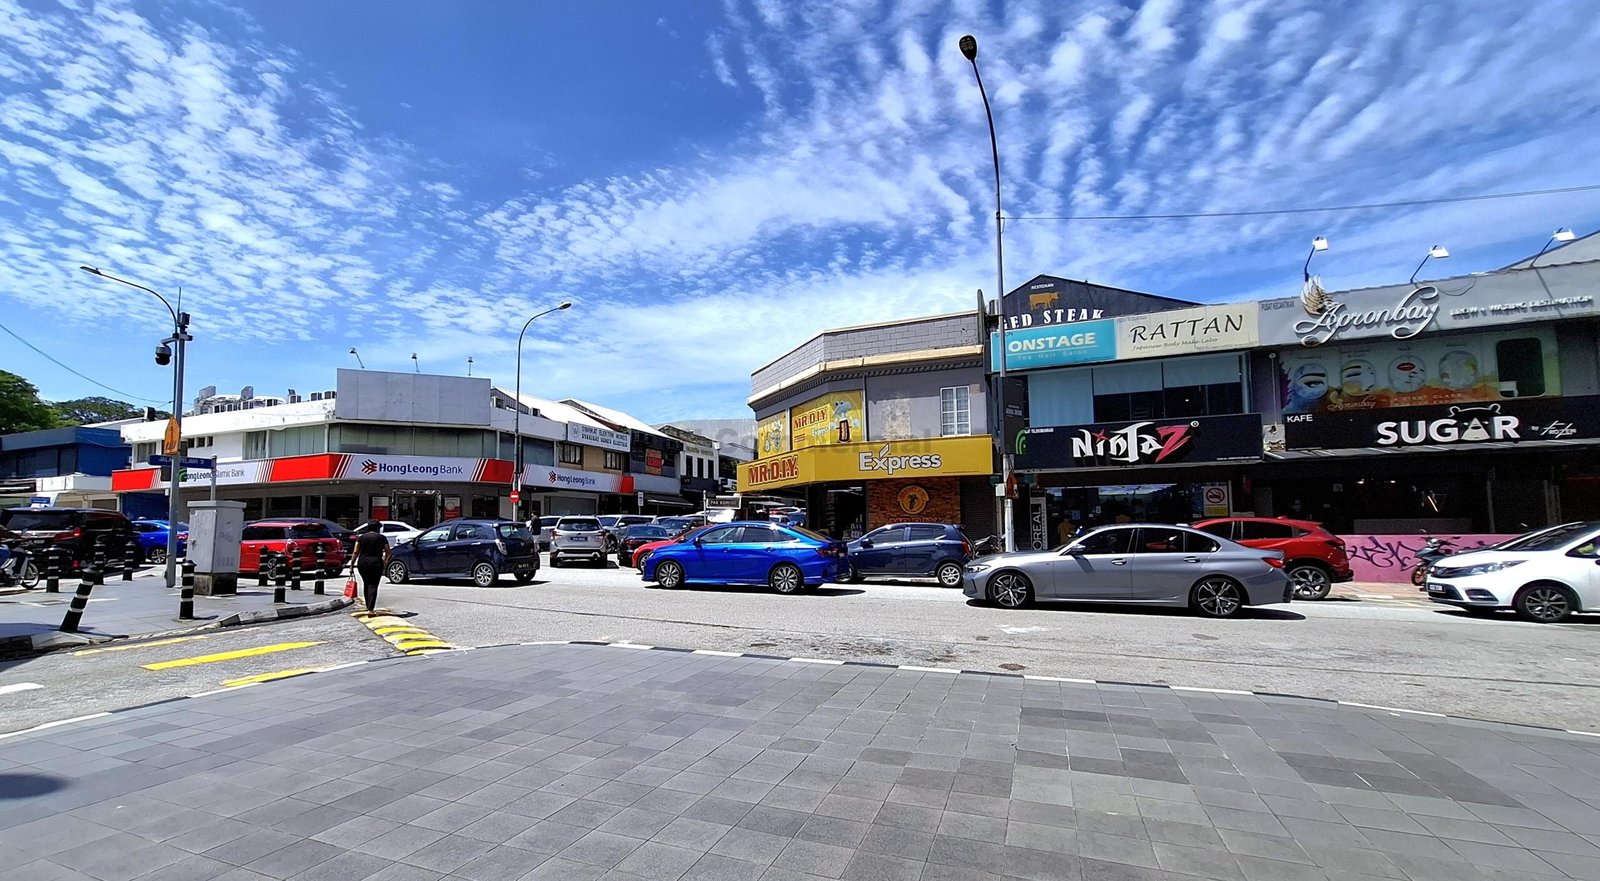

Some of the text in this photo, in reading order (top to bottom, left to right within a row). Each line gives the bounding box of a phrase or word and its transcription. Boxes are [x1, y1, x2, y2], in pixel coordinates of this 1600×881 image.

[1043, 308, 1104, 324] STEAK
[1293, 285, 1440, 347] Apronbay
[1130, 314, 1243, 343] RATTAN
[1008, 332, 1096, 353] ONSTAGE
[1132, 343, 1162, 352] Japanese
[1286, 413, 1313, 423] KAFE
[1376, 415, 1521, 445] SUGAR
[440, 464, 463, 474] Bank
[859, 444, 942, 475] Express
